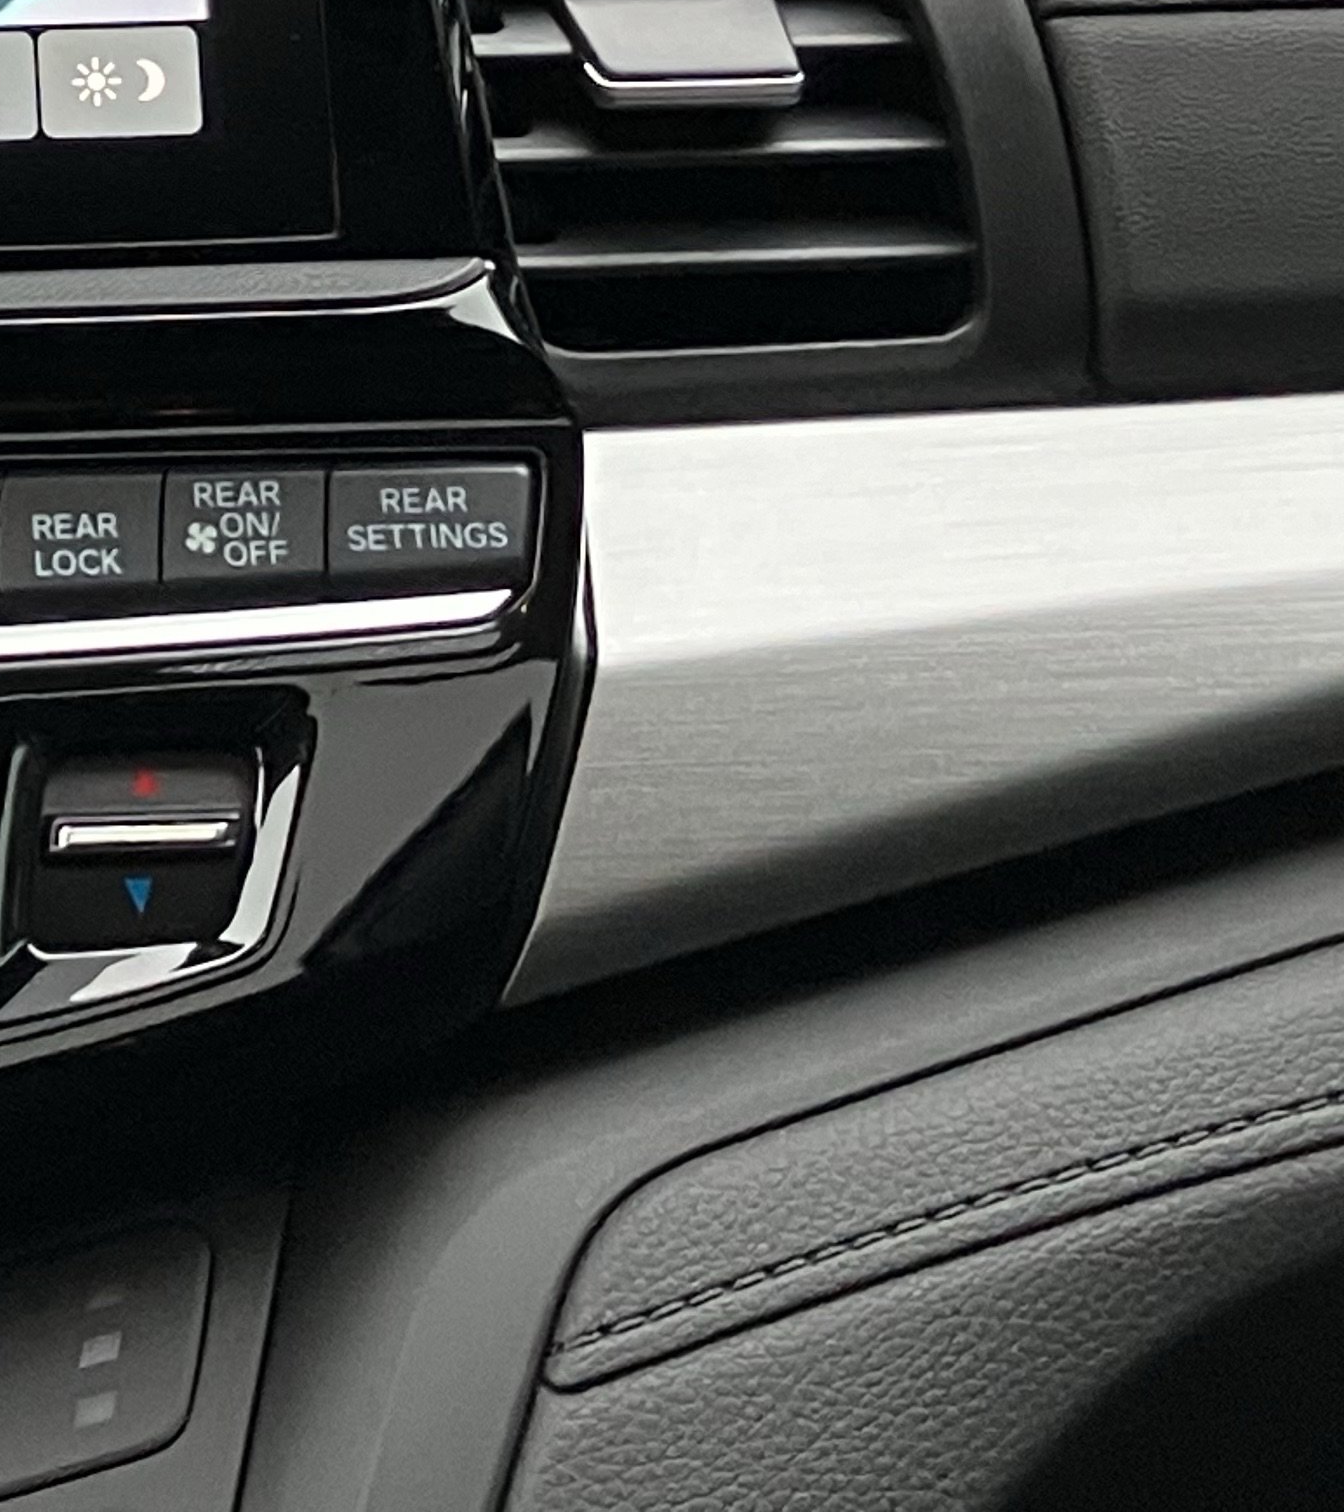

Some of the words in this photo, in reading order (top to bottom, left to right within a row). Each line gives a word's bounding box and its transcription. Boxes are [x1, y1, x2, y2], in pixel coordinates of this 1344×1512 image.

[193, 480, 281, 508] REAR
[380, 486, 468, 514] REAR
[31, 512, 119, 540] REAR
[347, 521, 509, 552] SETTINGS
[35, 548, 123, 577] LOCK
[223, 535, 288, 567] OFF
